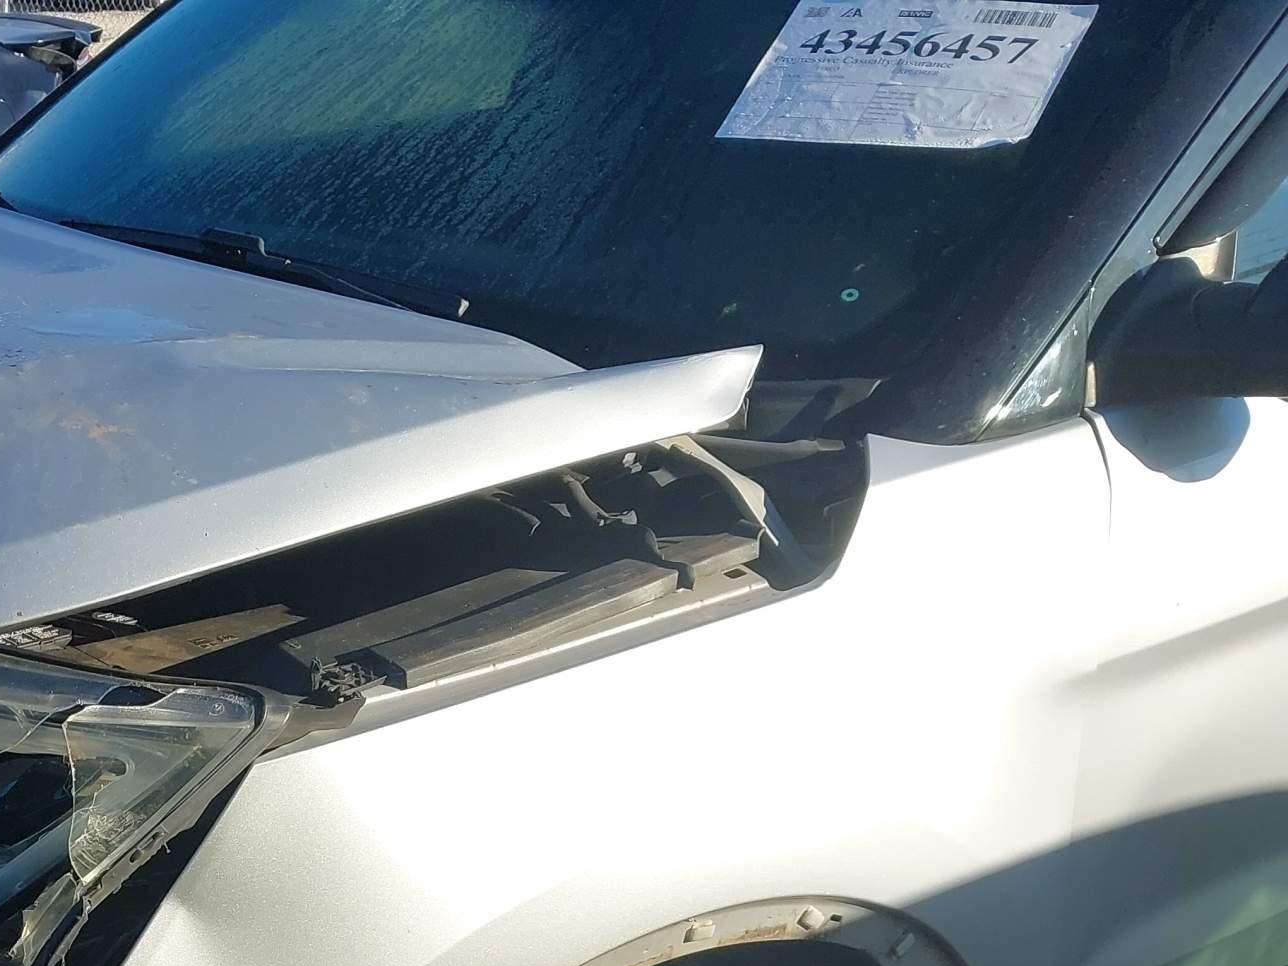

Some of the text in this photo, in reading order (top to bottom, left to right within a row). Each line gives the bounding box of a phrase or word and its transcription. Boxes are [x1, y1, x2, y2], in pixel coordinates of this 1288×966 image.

[799, 29, 1040, 64] 43456457
[775, 55, 955, 69] Progressive Casualty Insurance
